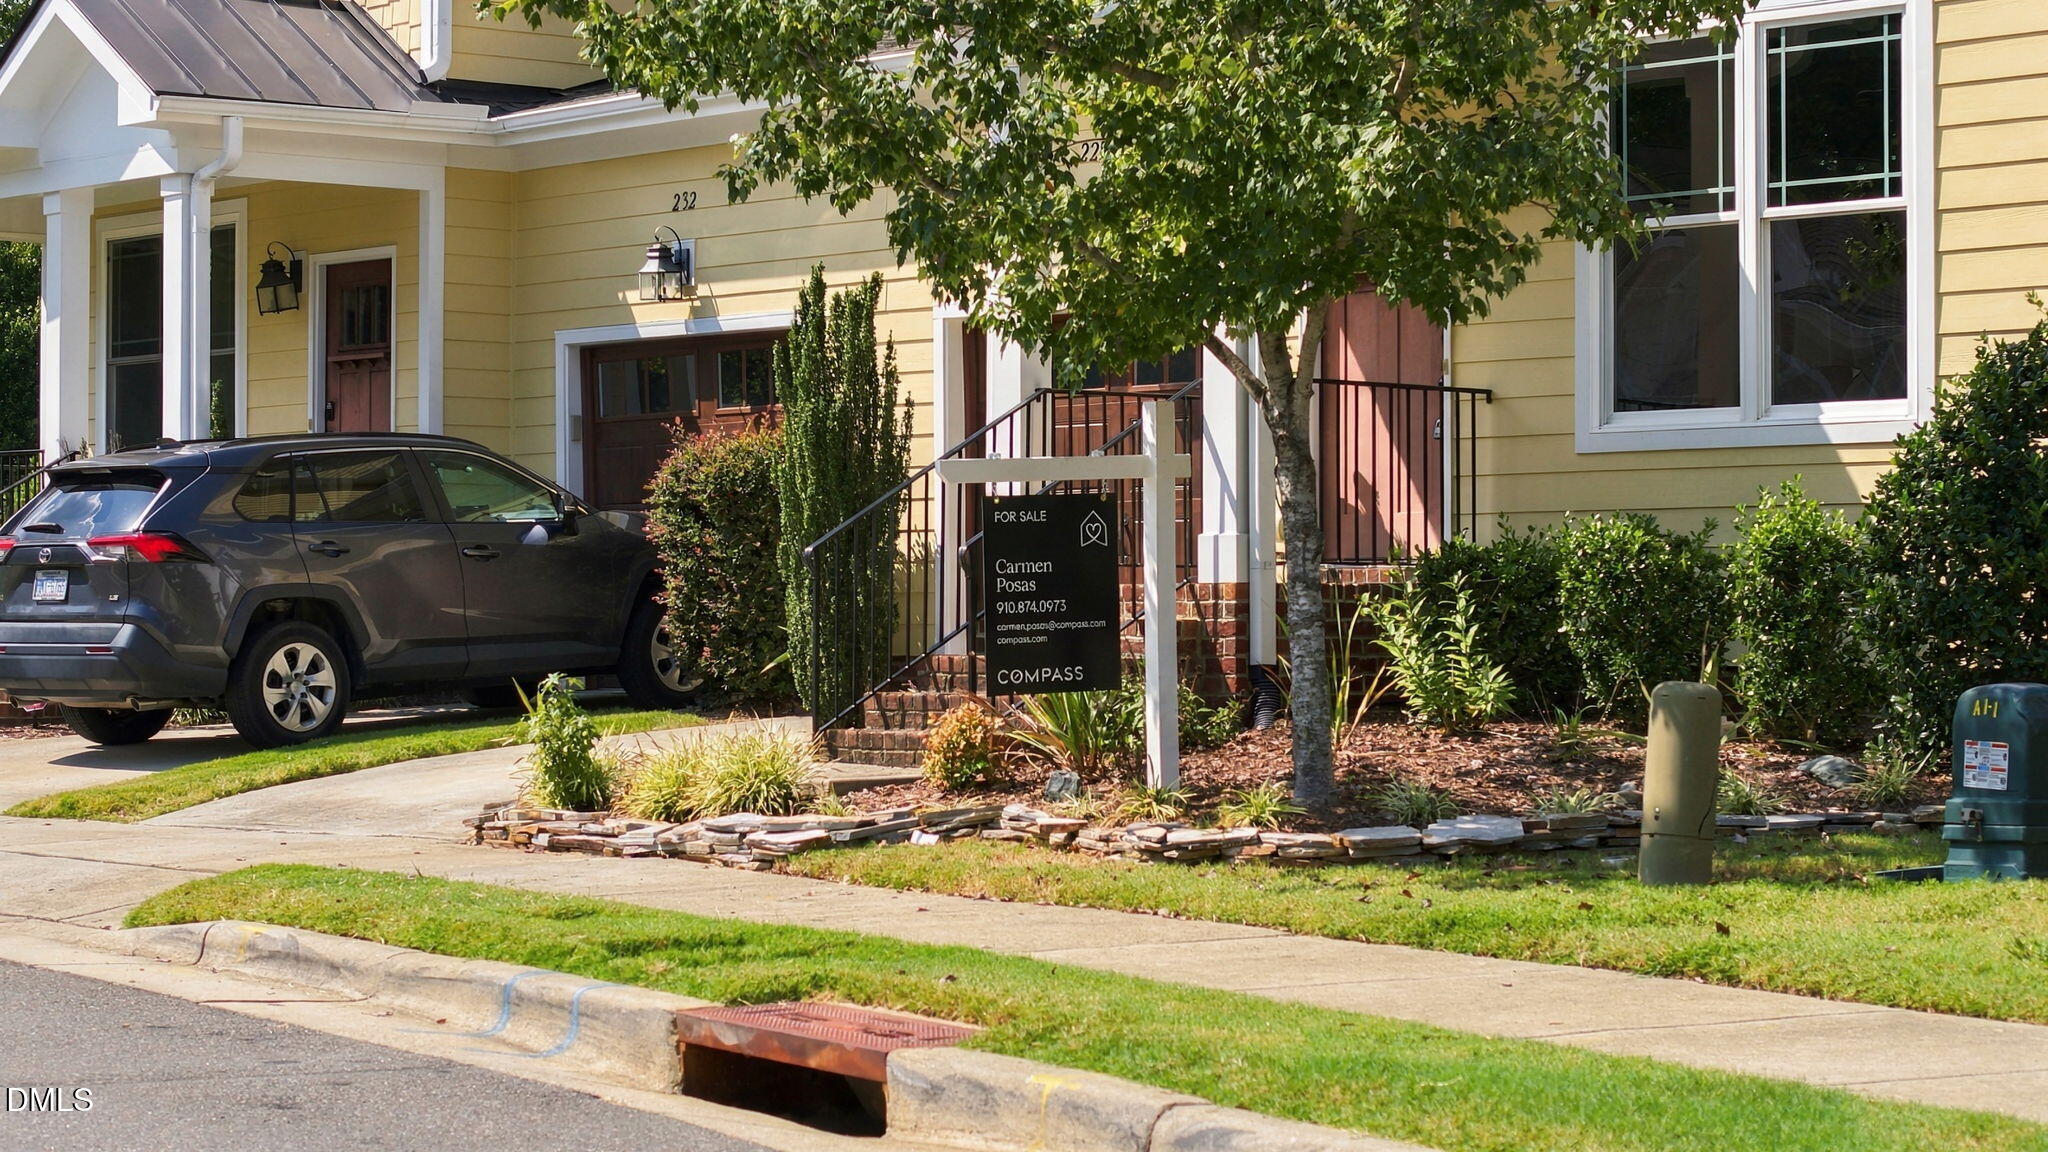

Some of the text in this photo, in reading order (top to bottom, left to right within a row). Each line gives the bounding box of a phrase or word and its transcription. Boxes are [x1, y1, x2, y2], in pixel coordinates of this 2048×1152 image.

[1081, 141, 1106, 162] 22
[672, 191, 696, 212] 232
[994, 510, 1047, 523] FOR SALE
[995, 558, 1053, 574] Carmen
[996, 577, 1037, 593] Posas
[996, 599, 1067, 614] 910.874.0973
[996, 620, 1106, 632] carmen.posas@compass.com
[996, 635, 1048, 646] compass.com
[997, 666, 1084, 685] COMPASS
